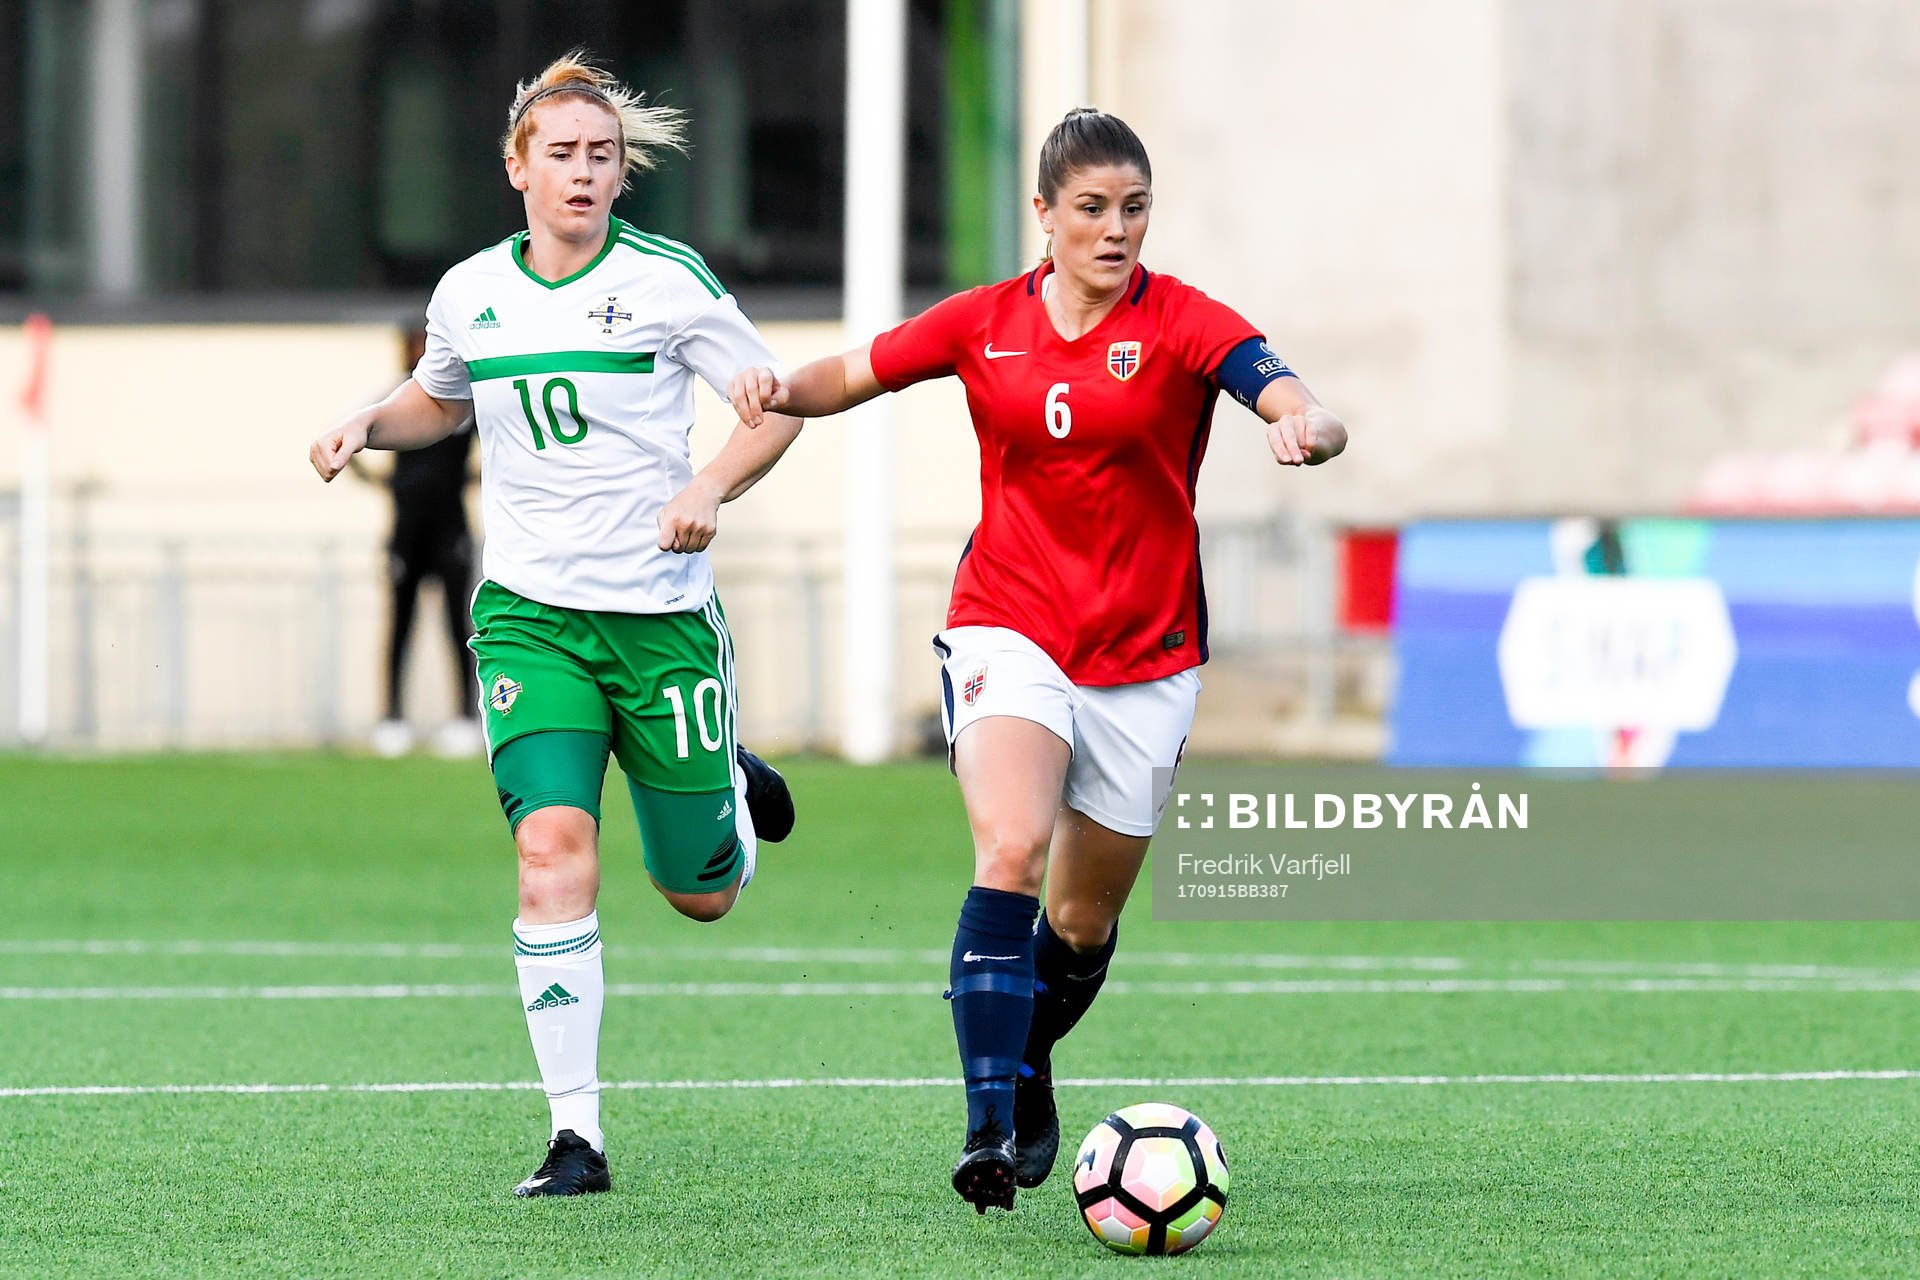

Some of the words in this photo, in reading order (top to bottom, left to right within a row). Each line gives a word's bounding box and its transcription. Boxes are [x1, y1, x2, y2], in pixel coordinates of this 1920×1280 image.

[469, 320, 501, 330] adidas
[513, 377, 588, 451] 10
[1045, 382, 1072, 440] 6
[662, 677, 723, 760] 10
[527, 996, 579, 1012] adidas
